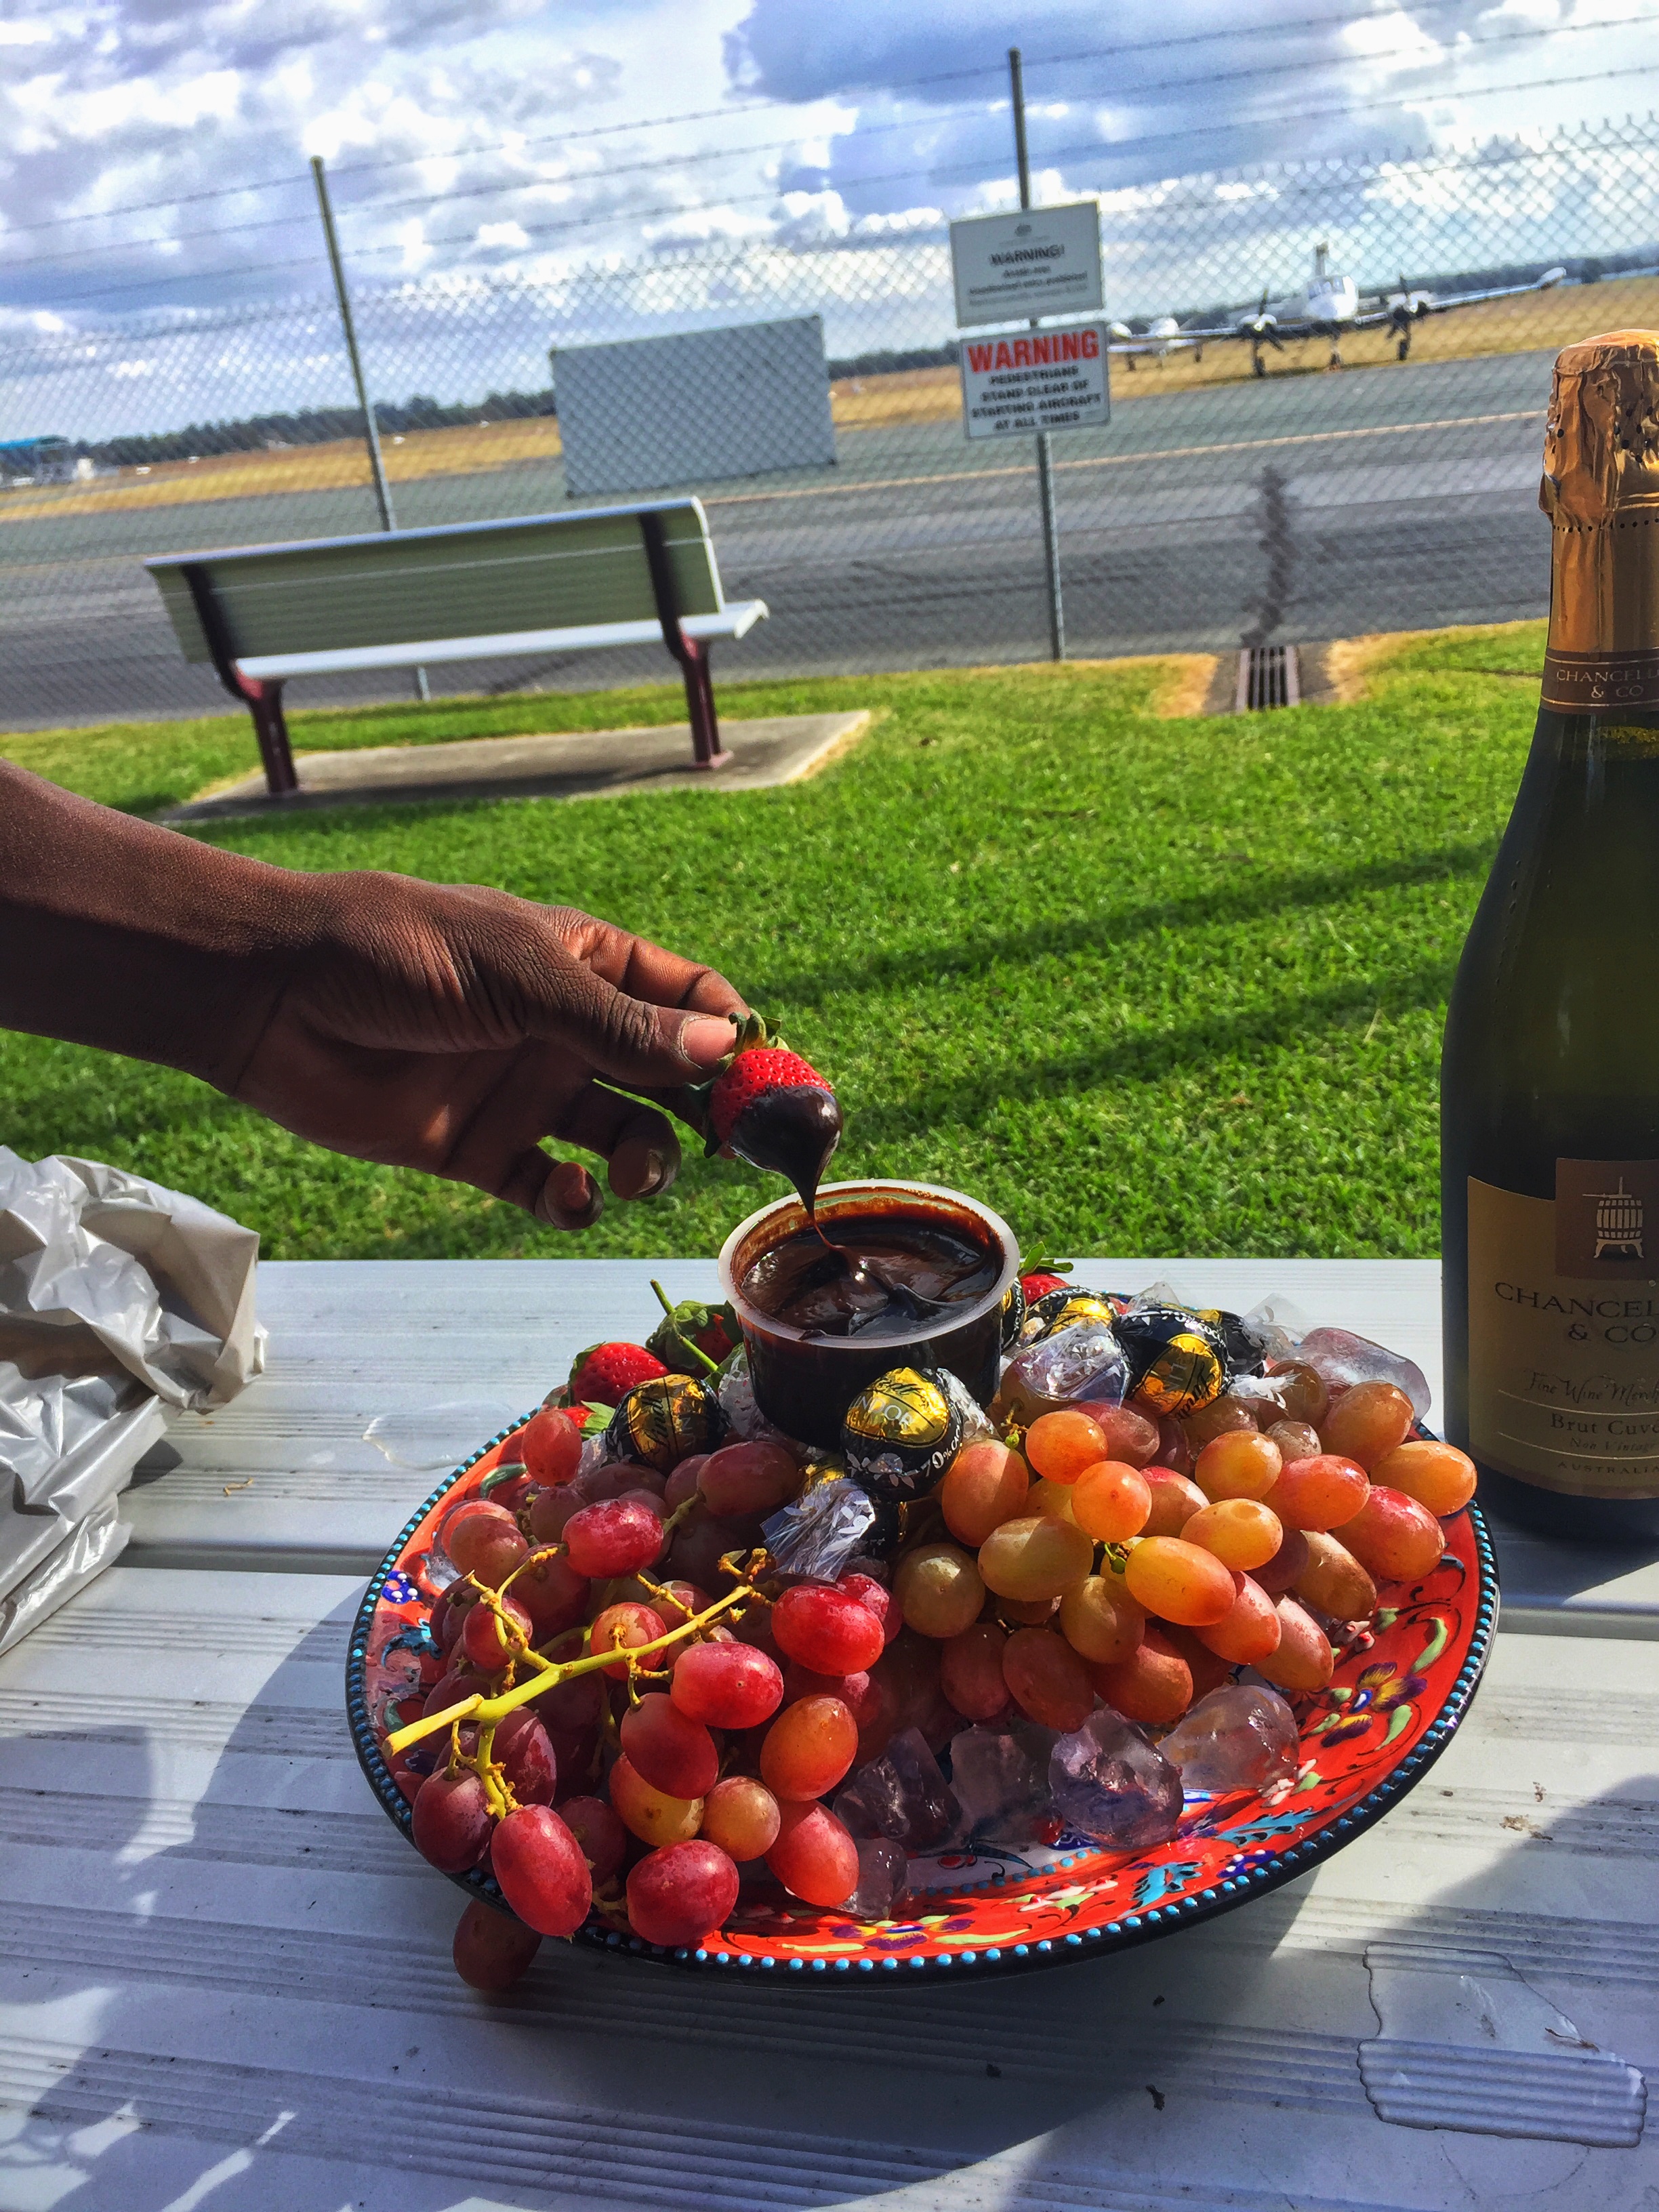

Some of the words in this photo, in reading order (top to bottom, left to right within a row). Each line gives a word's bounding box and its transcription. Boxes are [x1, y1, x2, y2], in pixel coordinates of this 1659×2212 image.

[968, 329, 1099, 373] WARNING
[981, 388, 1023, 402] STAND
[1027, 382, 1069, 396] CLEAR
[1072, 378, 1088, 391] OF
[972, 401, 1034, 418] STARTING
[1040, 393, 1101, 409] AIRCRAFT
[995, 419, 1010, 431] AT
[1014, 416, 1036, 428] ALL
[1040, 411, 1080, 424] TIMES
[1591, 685, 1605, 699] &
[1616, 685, 1644, 698] CO
[1568, 1324, 1591, 1341] &
[1605, 1326, 1657, 1343] CO
[1526, 1371, 1558, 1394] Fine
[1560, 1375, 1604, 1404] Wine
[1551, 1413, 1597, 1433] Brut
[1570, 1437, 1597, 1450] Non
